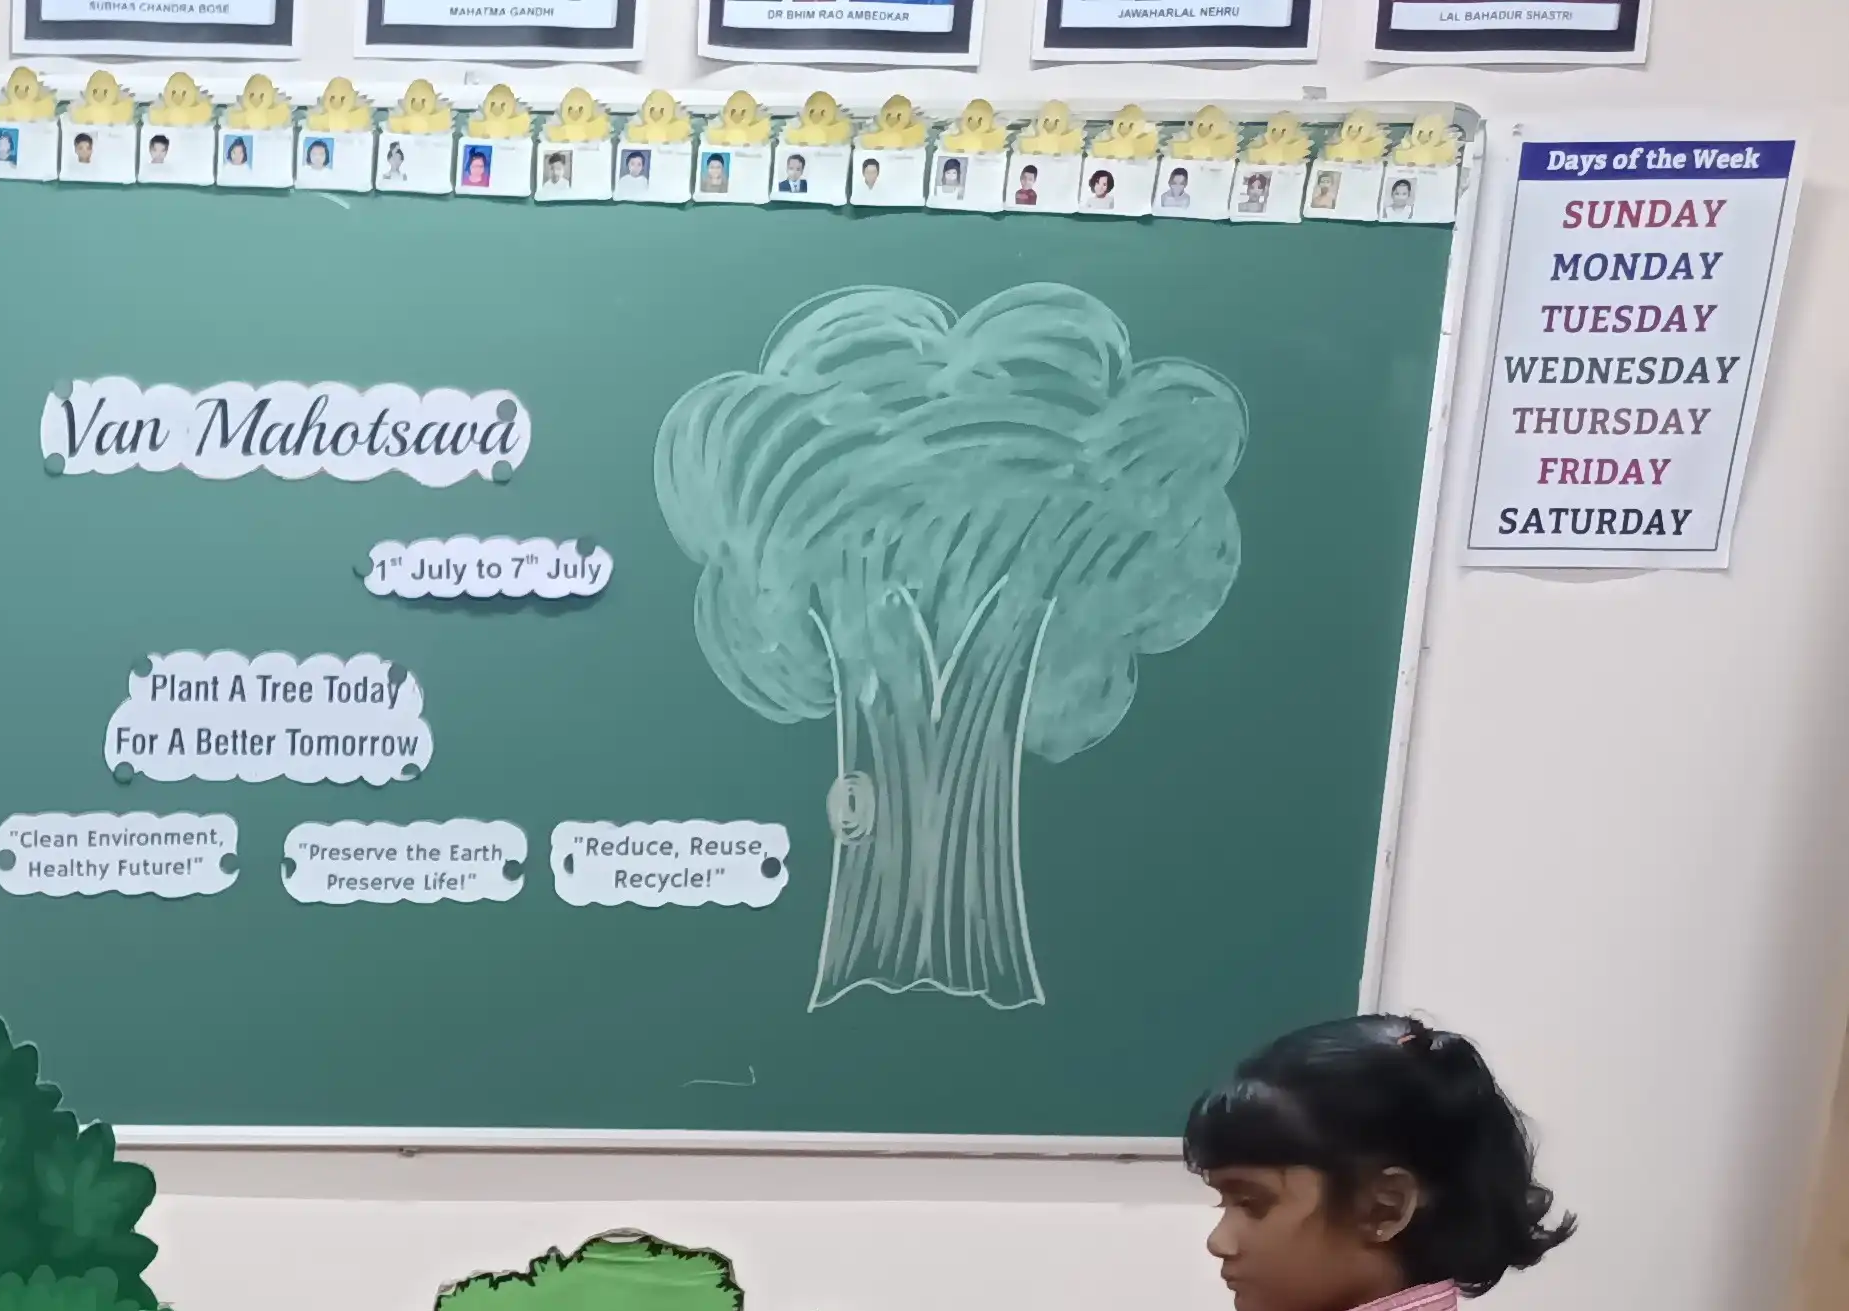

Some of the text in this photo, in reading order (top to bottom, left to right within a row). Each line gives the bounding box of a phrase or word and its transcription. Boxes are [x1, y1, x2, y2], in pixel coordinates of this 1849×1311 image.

[139, 3, 195, 13] CHANDRA
[199, 4, 229, 14] BOSE
[449, 7, 554, 17] MAHATMA GANDHI
[768, 10, 909, 21] DR BHIM RAO AMBEDKAR
[1118, 7, 1240, 18] JAWAHARLAL NEHRU
[1439, 11, 1572, 21] LAL BAHADUR SHASTRI
[1547, 148, 1759, 176] Days of the Week
[1562, 199, 1727, 229] SUNDAY
[1550, 252, 1723, 281] MONDAY
[1541, 304, 1717, 333] TUESDAY
[1504, 356, 1740, 385] WEDNESDAY
[61, 394, 522, 459] Van Mahotsava
[1512, 407, 1711, 436] THURSDAY
[1537, 457, 1671, 485] FRIDAY
[1498, 507, 1692, 537] SATURDAY
[375, 554, 601, 586] 1st July to 7th July
[151, 674, 401, 709] Plant A Tree Today
[116, 727, 419, 757] For A Better Tomorrow
[9, 829, 224, 848] "Clean Environment,
[298, 842, 397, 861] "Preserve
[406, 843, 440, 861] the
[573, 836, 769, 860] "Reduce, Reuse,
[28, 857, 204, 881] Healthy Future!"
[326, 873, 477, 891] Preserve Life!"
[614, 868, 726, 890] Recycle!"
